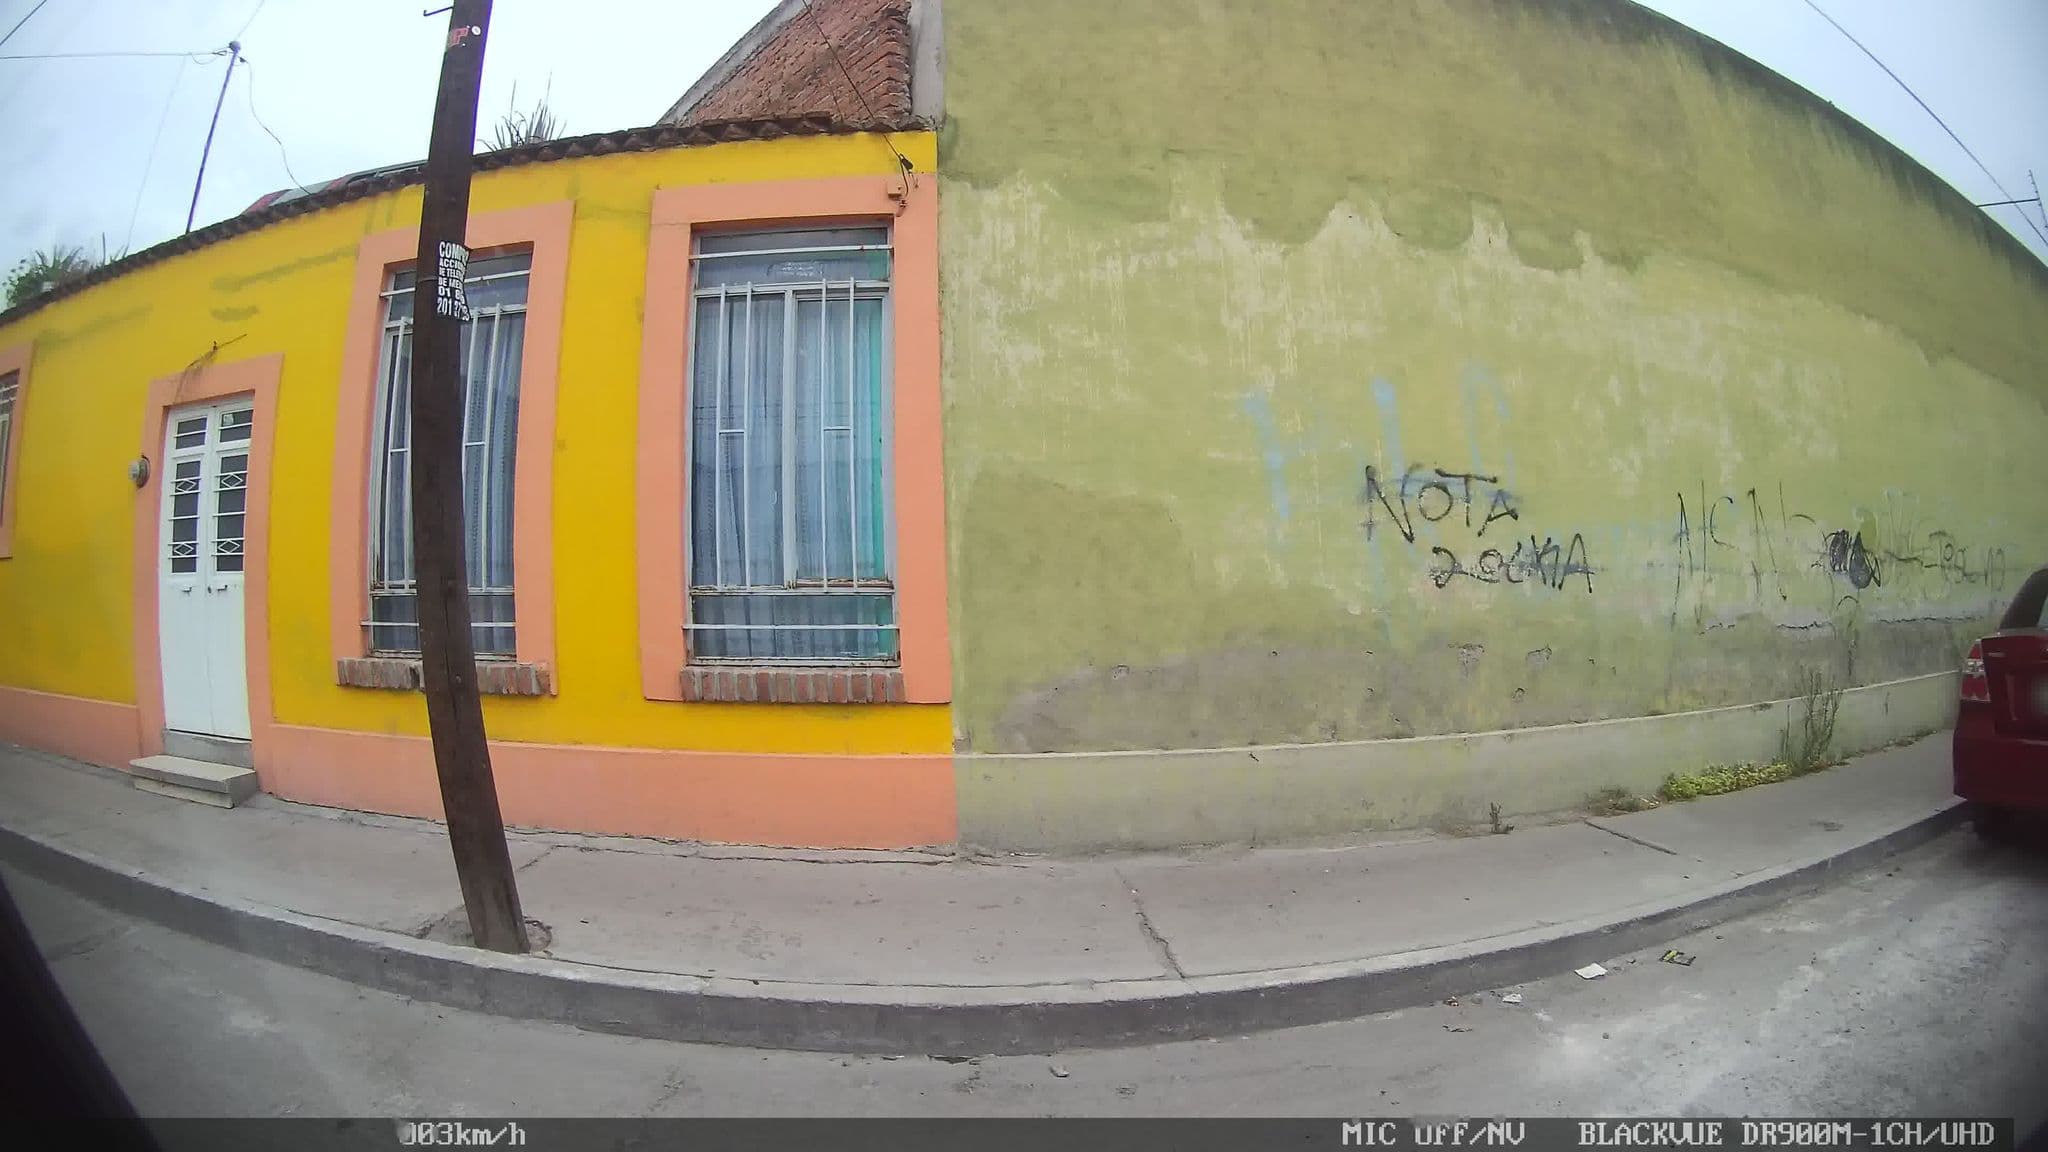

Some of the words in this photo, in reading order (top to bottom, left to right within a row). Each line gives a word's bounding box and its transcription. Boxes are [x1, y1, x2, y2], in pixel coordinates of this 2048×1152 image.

[439, 267, 446, 277] DE
[438, 277, 448, 287] DE
[437, 297, 452, 316] 201
[1360, 464, 1519, 543] NOTA
